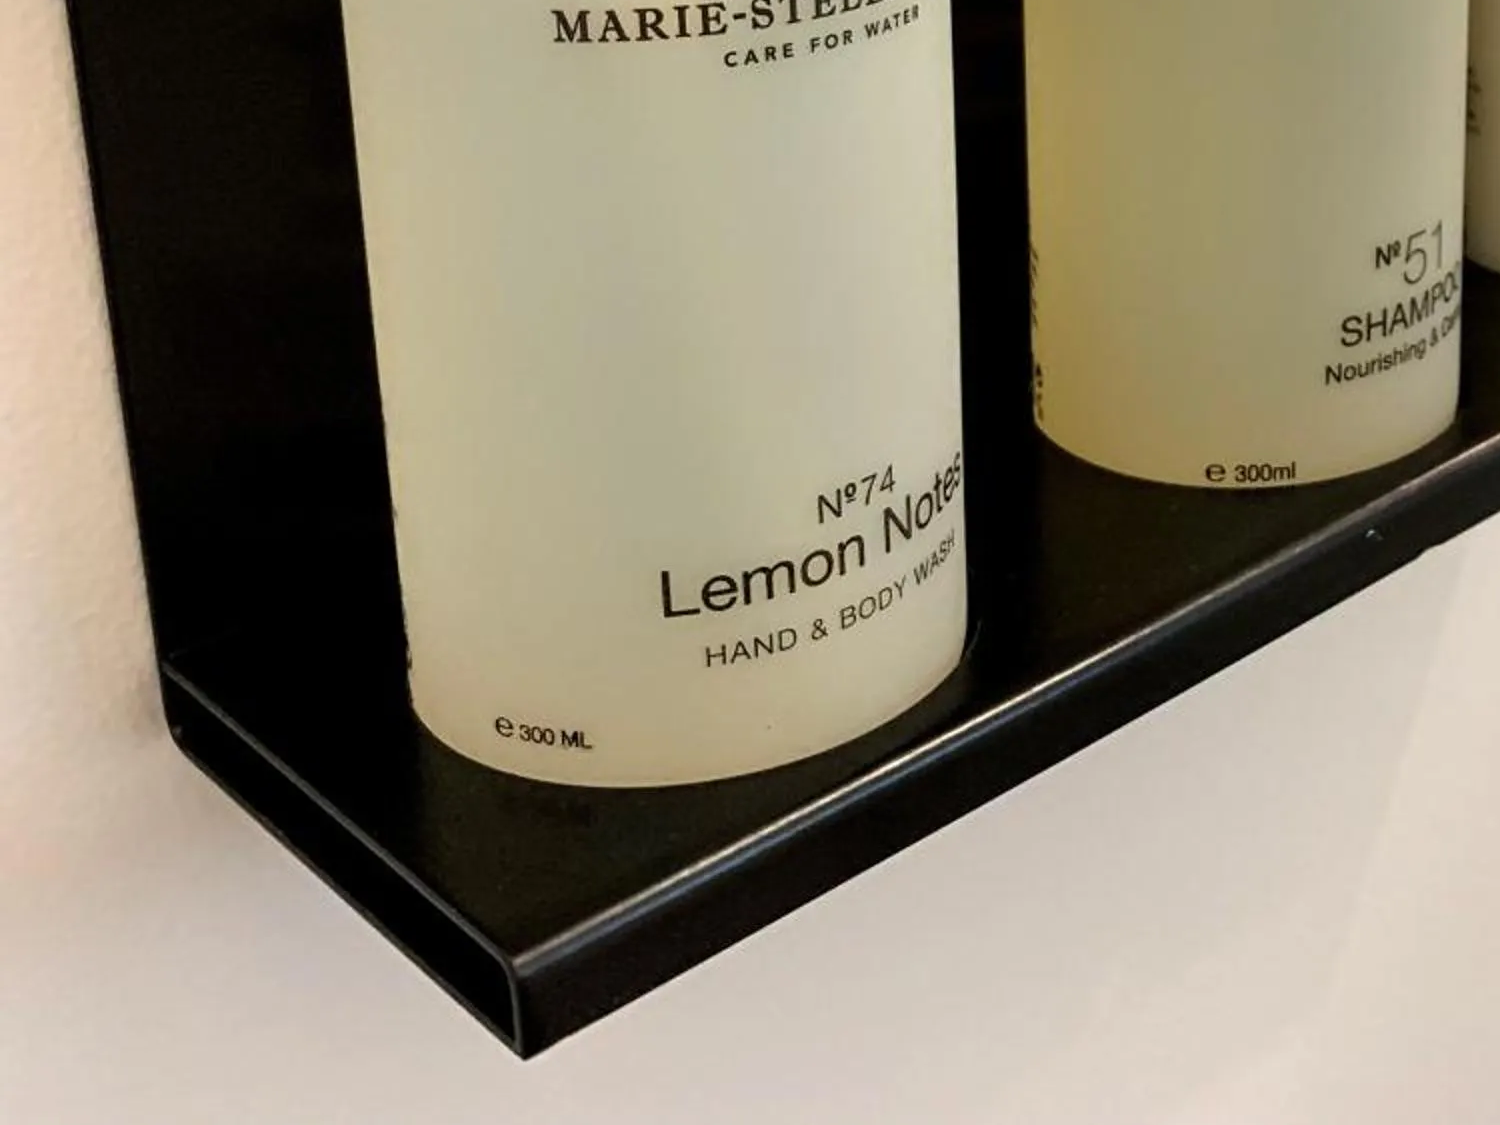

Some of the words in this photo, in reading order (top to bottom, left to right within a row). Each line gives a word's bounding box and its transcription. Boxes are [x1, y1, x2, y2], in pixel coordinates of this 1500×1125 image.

[723, 41, 796, 68] CARE
[810, 28, 855, 55] FOR
[863, 4, 921, 40] WATER
[1325, 337, 1427, 387] Nourishing
[1234, 461, 1297, 483] 300ml
[660, 533, 867, 618] Lemon
[882, 452, 961, 554] Notes
[704, 627, 798, 668] HAND
[810, 618, 830, 641] &
[839, 575, 906, 631] BODY
[912, 528, 956, 586] WASH
[518, 723, 556, 746] 300
[560, 729, 593, 750] ML
